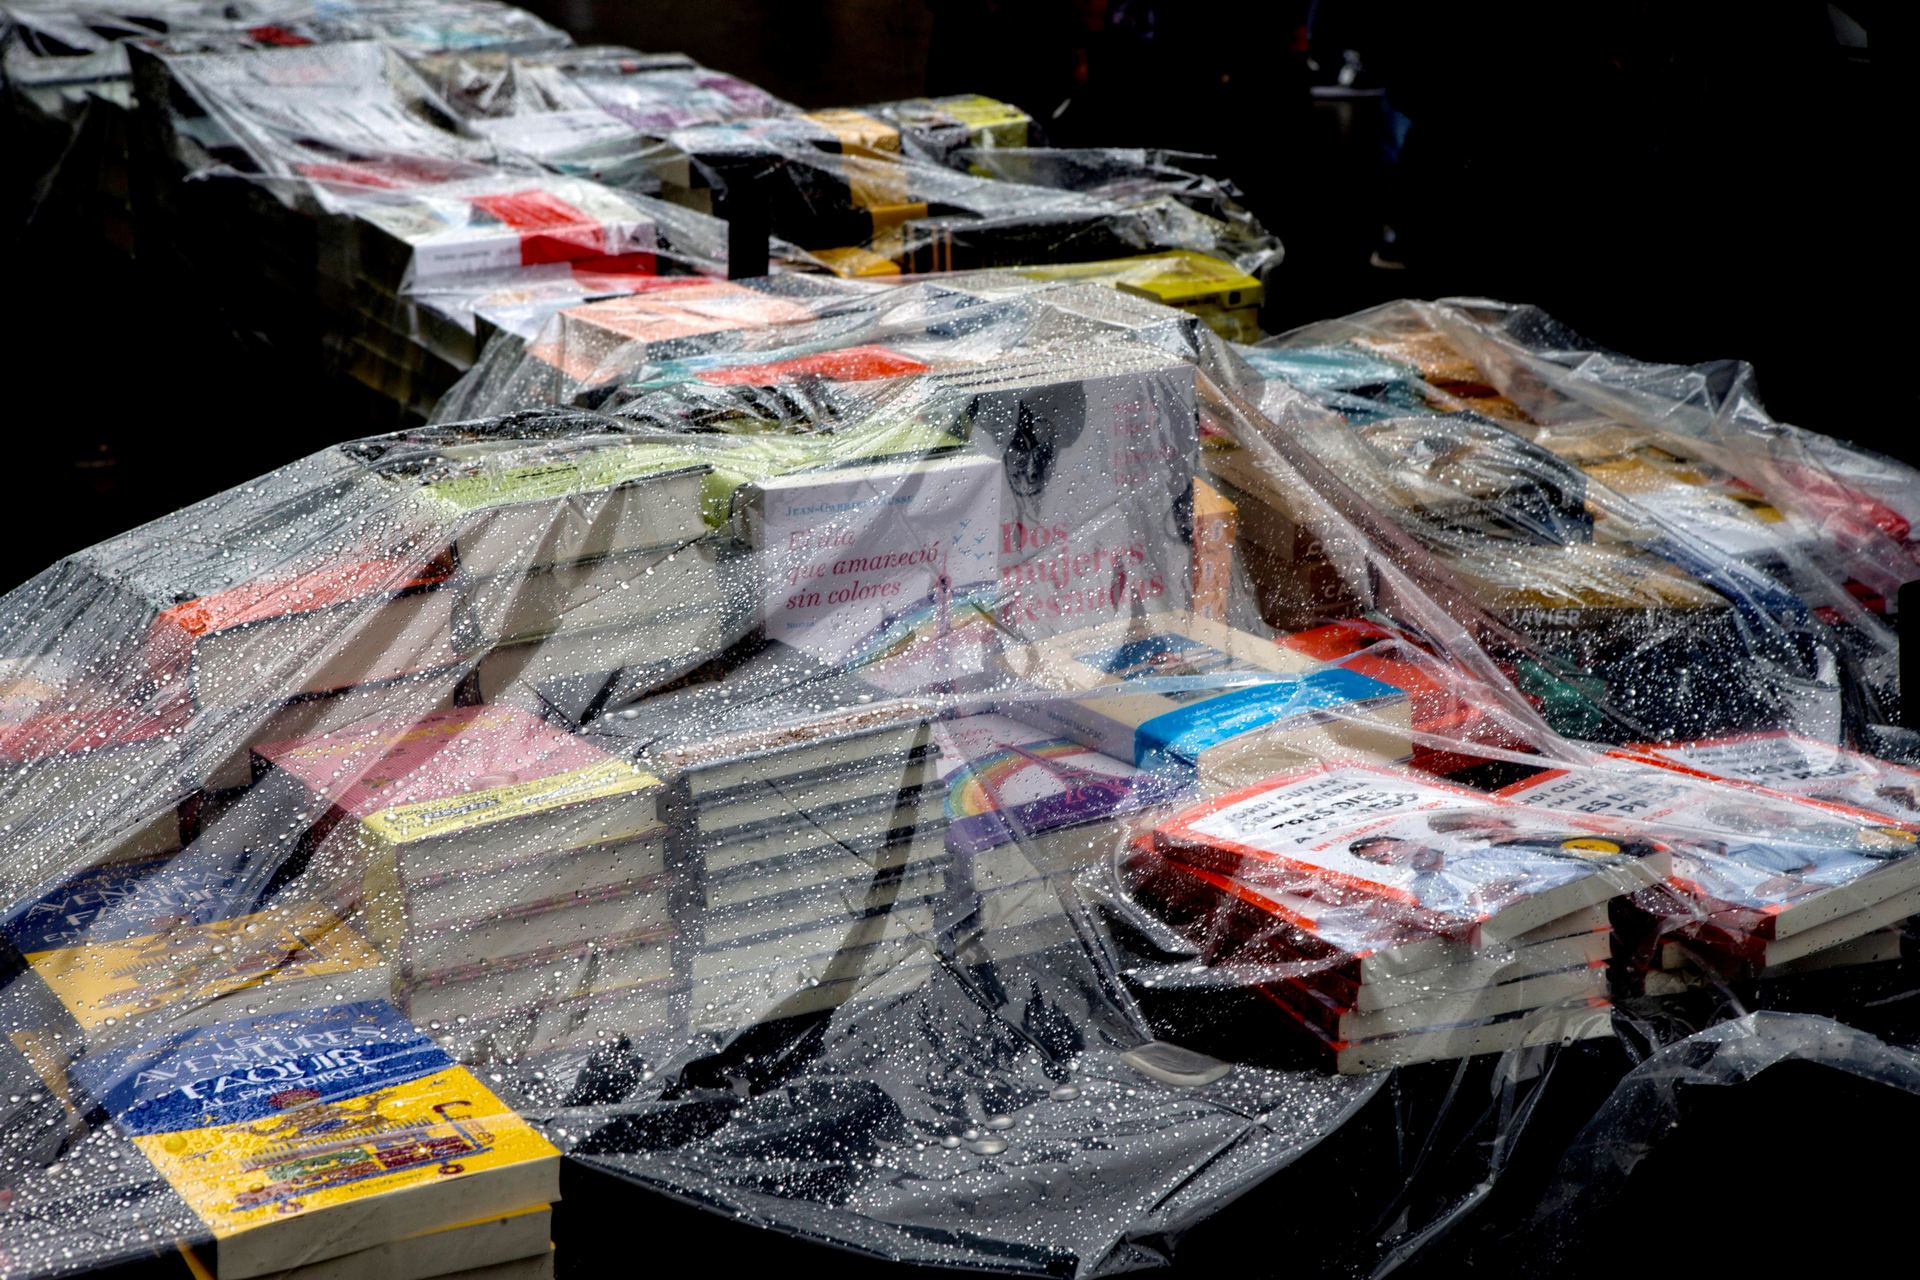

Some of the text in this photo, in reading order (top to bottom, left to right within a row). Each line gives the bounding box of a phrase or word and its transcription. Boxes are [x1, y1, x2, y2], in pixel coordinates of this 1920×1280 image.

[1000, 521, 1069, 555] Dos
[831, 540, 942, 576] amaneció
[786, 588, 821, 610] sin
[827, 579, 902, 606] colores
[1510, 608, 1581, 626] JAVIER
[42, 927, 82, 943] EN
[133, 1025, 382, 1090] AVENTURES
[180, 1048, 388, 1100] FAQUIR
